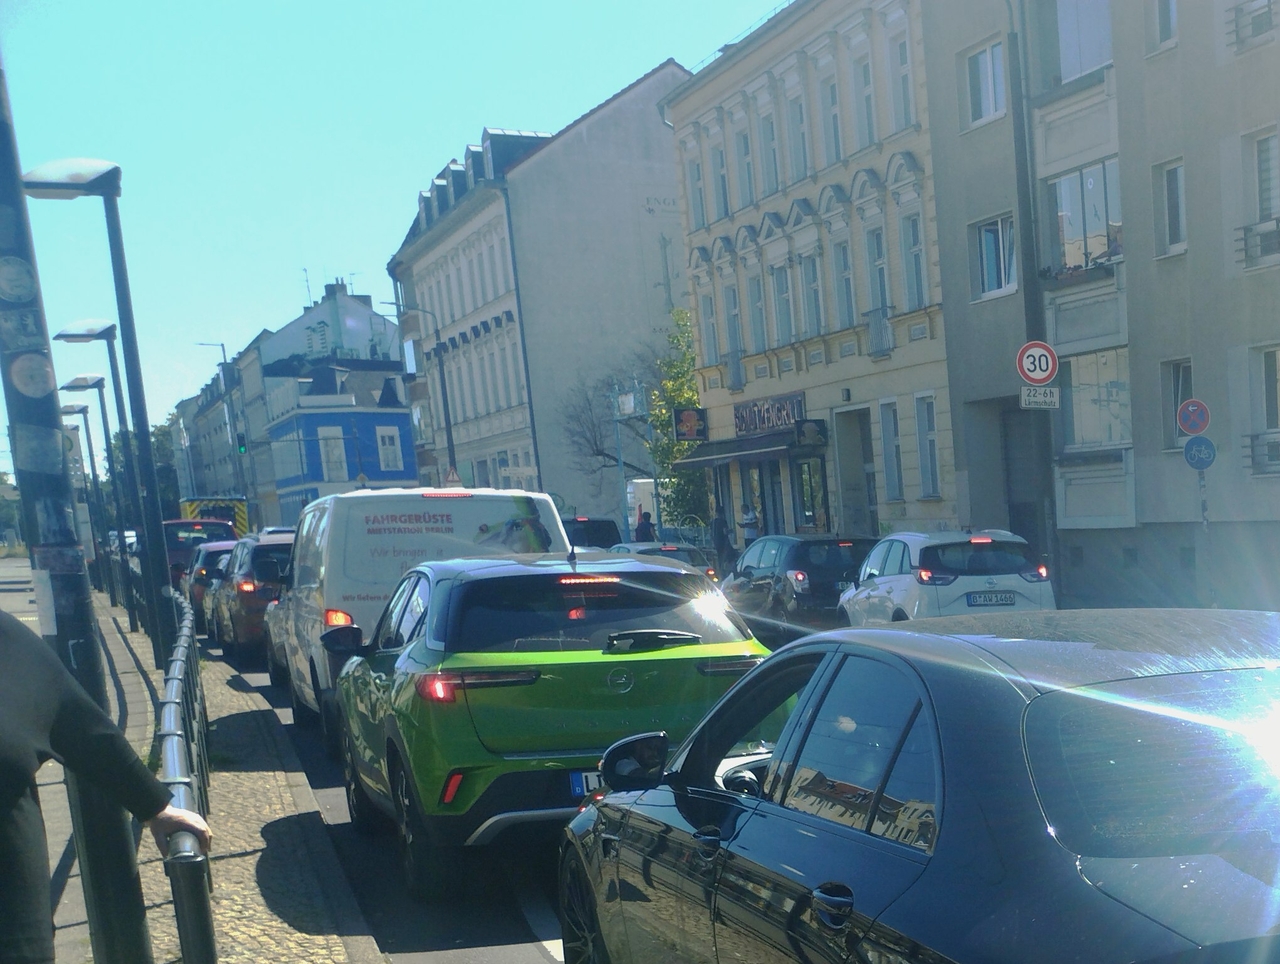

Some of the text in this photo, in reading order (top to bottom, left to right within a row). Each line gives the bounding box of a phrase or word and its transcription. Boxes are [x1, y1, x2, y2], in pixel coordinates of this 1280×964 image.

[1026, 353, 1049, 373] 30
[1025, 399, 1056, 407] Lärmschutz
[365, 511, 453, 525] FAHRGERÜSTE
[367, 526, 454, 535] MIETSTATION BERLIN
